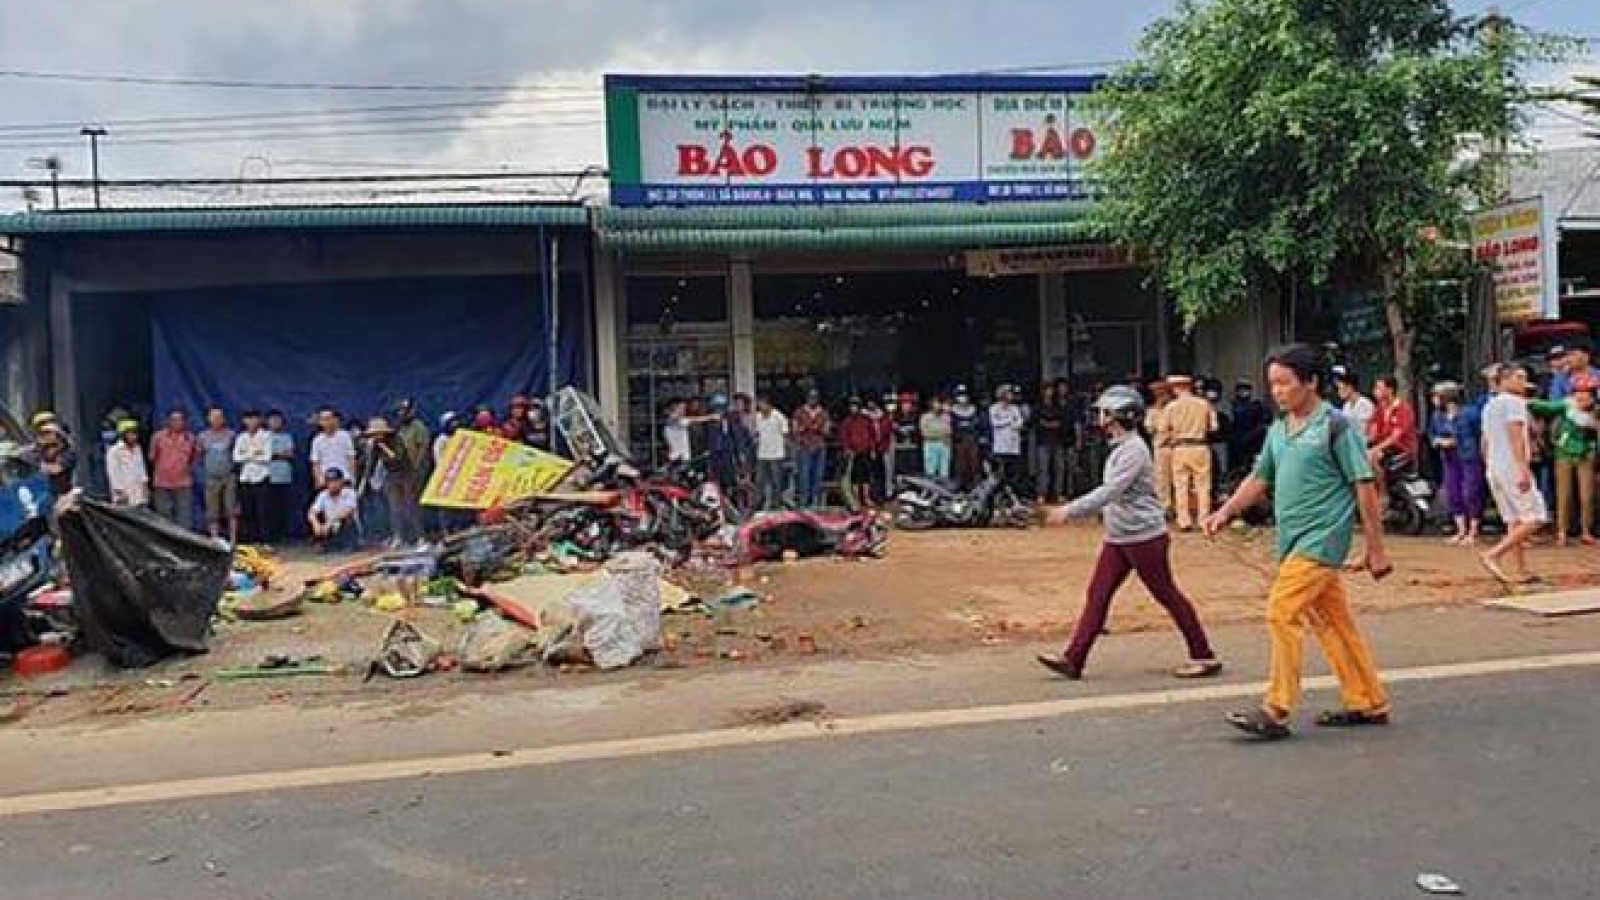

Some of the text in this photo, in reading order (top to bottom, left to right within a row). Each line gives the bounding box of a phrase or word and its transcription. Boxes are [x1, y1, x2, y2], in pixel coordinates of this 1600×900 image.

[676, 129, 935, 178] BẢO LONG
[1009, 113, 1096, 160] BẢO
